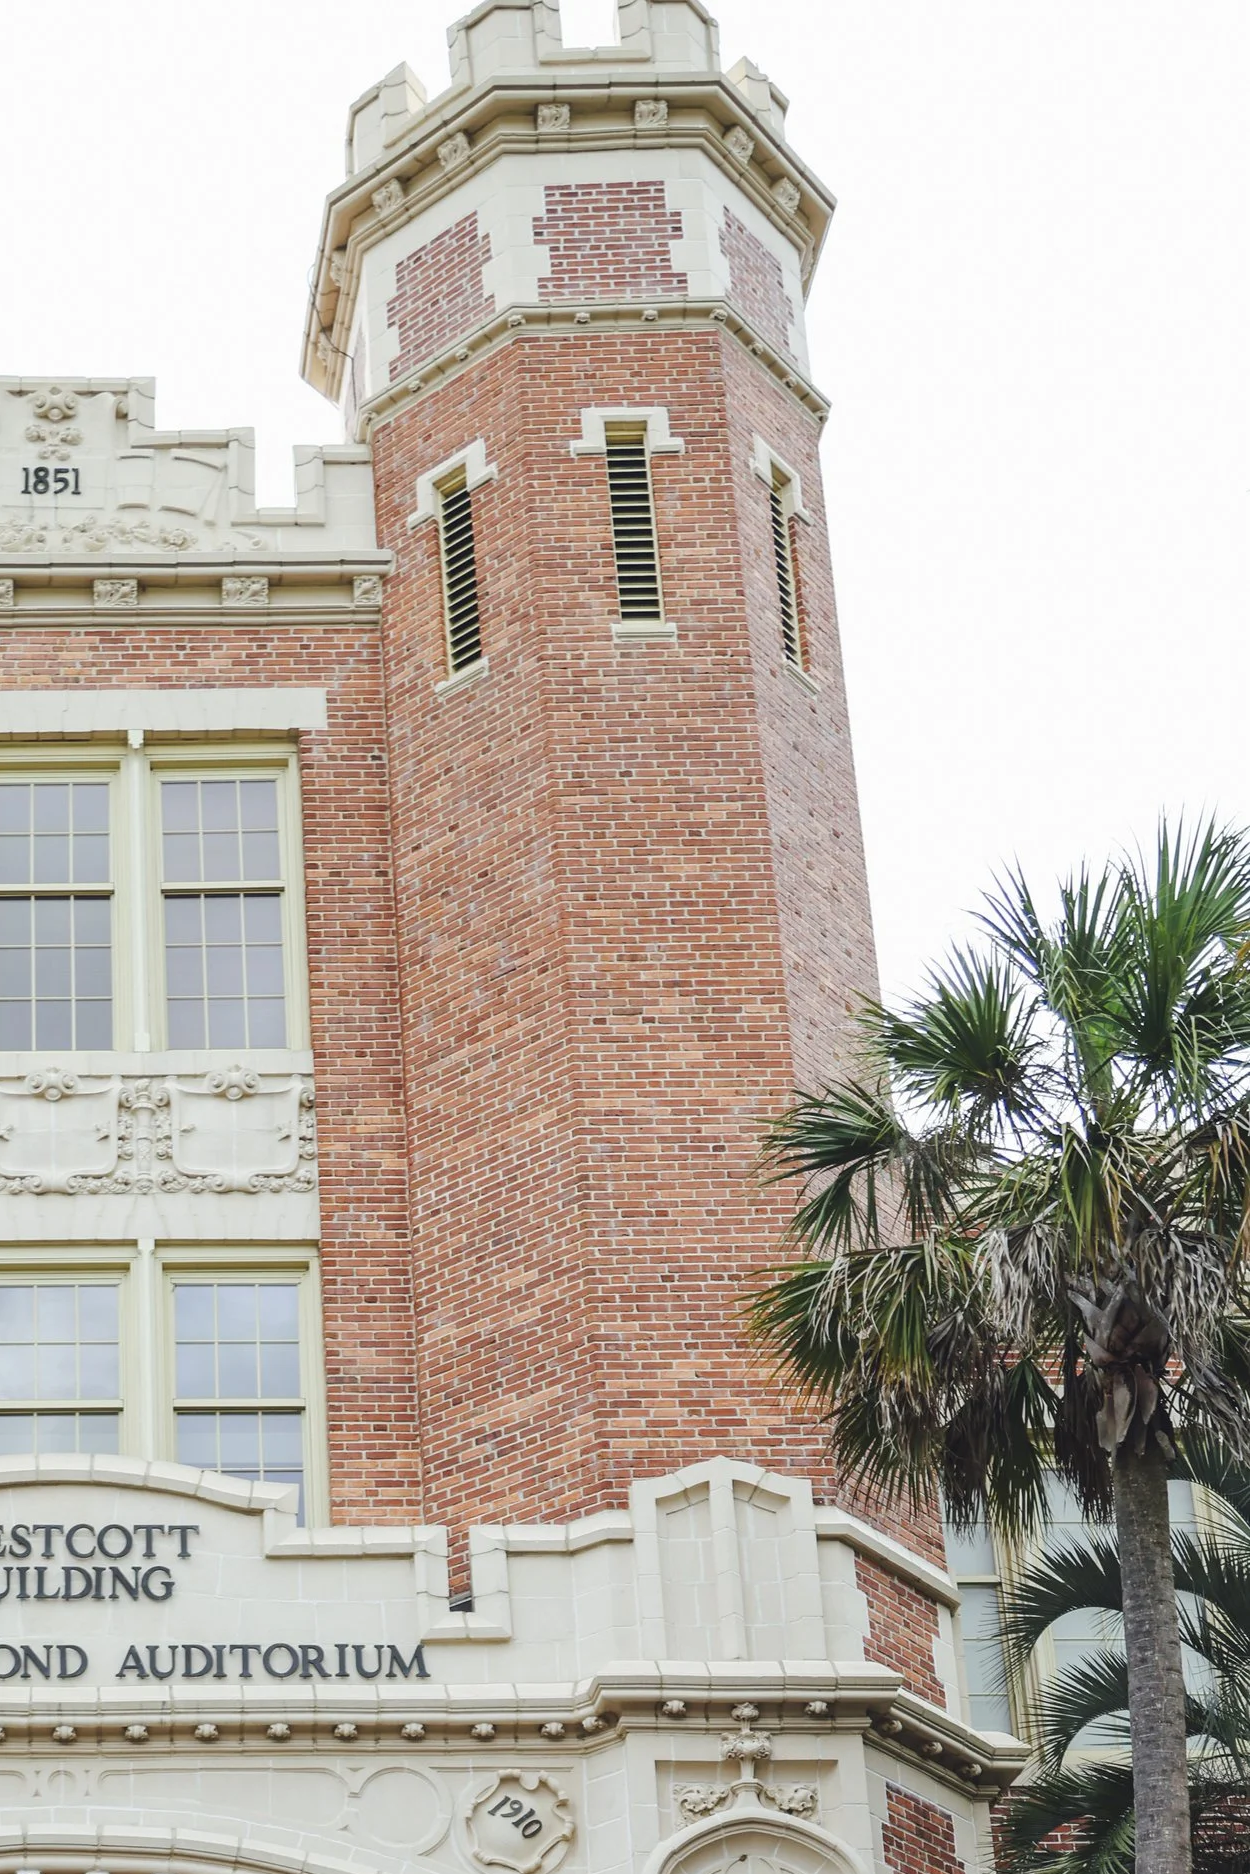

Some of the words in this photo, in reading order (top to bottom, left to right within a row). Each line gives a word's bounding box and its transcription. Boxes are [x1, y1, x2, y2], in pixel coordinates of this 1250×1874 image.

[21, 466, 82, 495] 1851
[115, 1643, 431, 1680] AUDITORIUM
[487, 1795, 543, 1839] 1910
